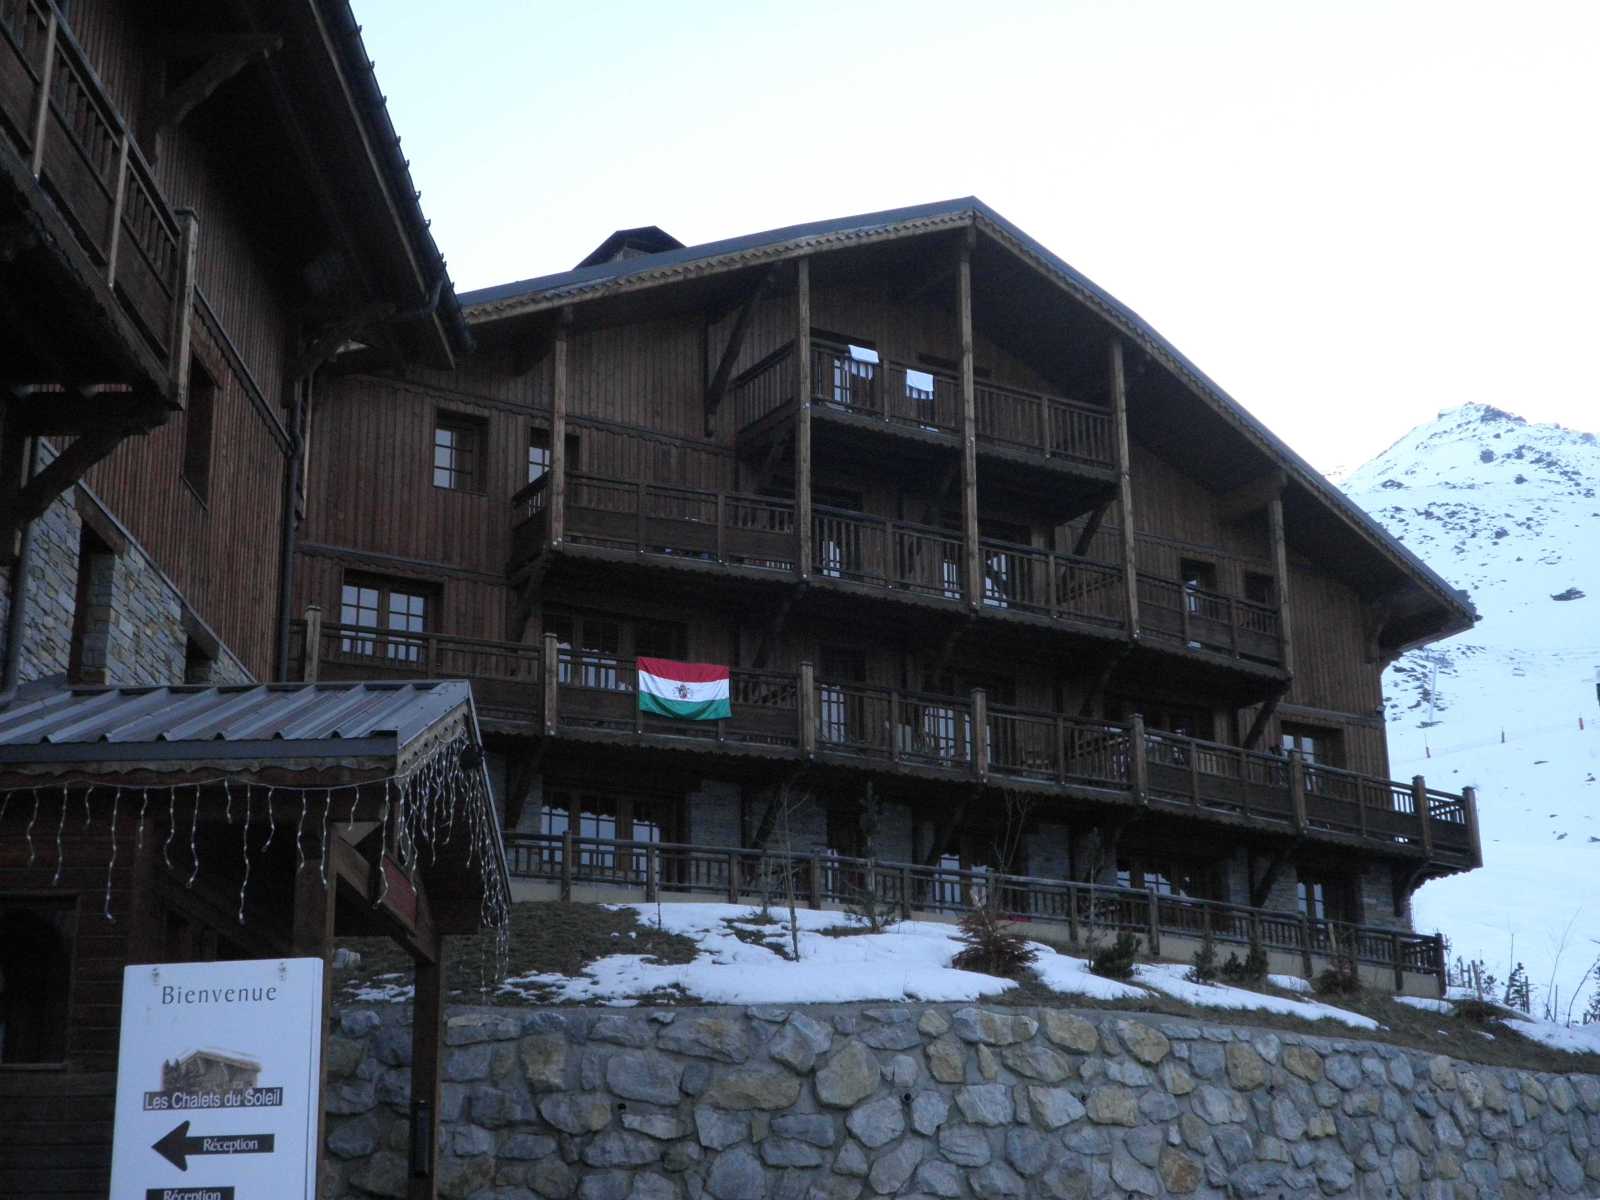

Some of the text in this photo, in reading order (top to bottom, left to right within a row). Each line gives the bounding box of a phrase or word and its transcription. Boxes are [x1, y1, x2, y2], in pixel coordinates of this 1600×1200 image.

[162, 985, 277, 1005] Bienvenue
[145, 1088, 281, 1110] Les Chalets du Soleil
[203, 1138, 258, 1154] Réception
